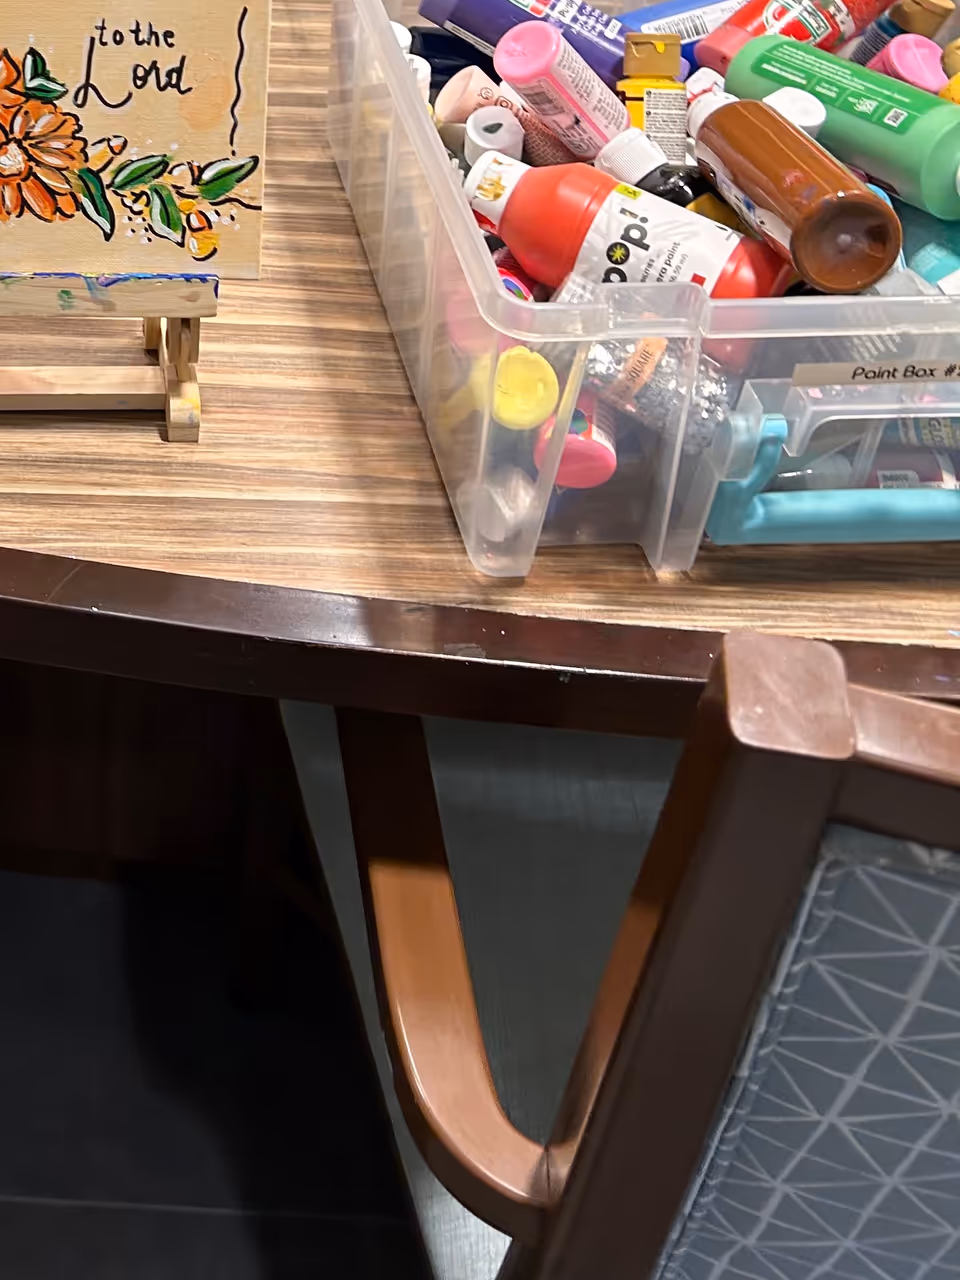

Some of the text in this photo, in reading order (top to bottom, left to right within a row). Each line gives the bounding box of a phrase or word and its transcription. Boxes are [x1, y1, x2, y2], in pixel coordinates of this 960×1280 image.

[95, 18, 176, 48] to the
[72, 35, 194, 109] Lord
[851, 366, 898, 380] Paint
[903, 364, 937, 378] Box
